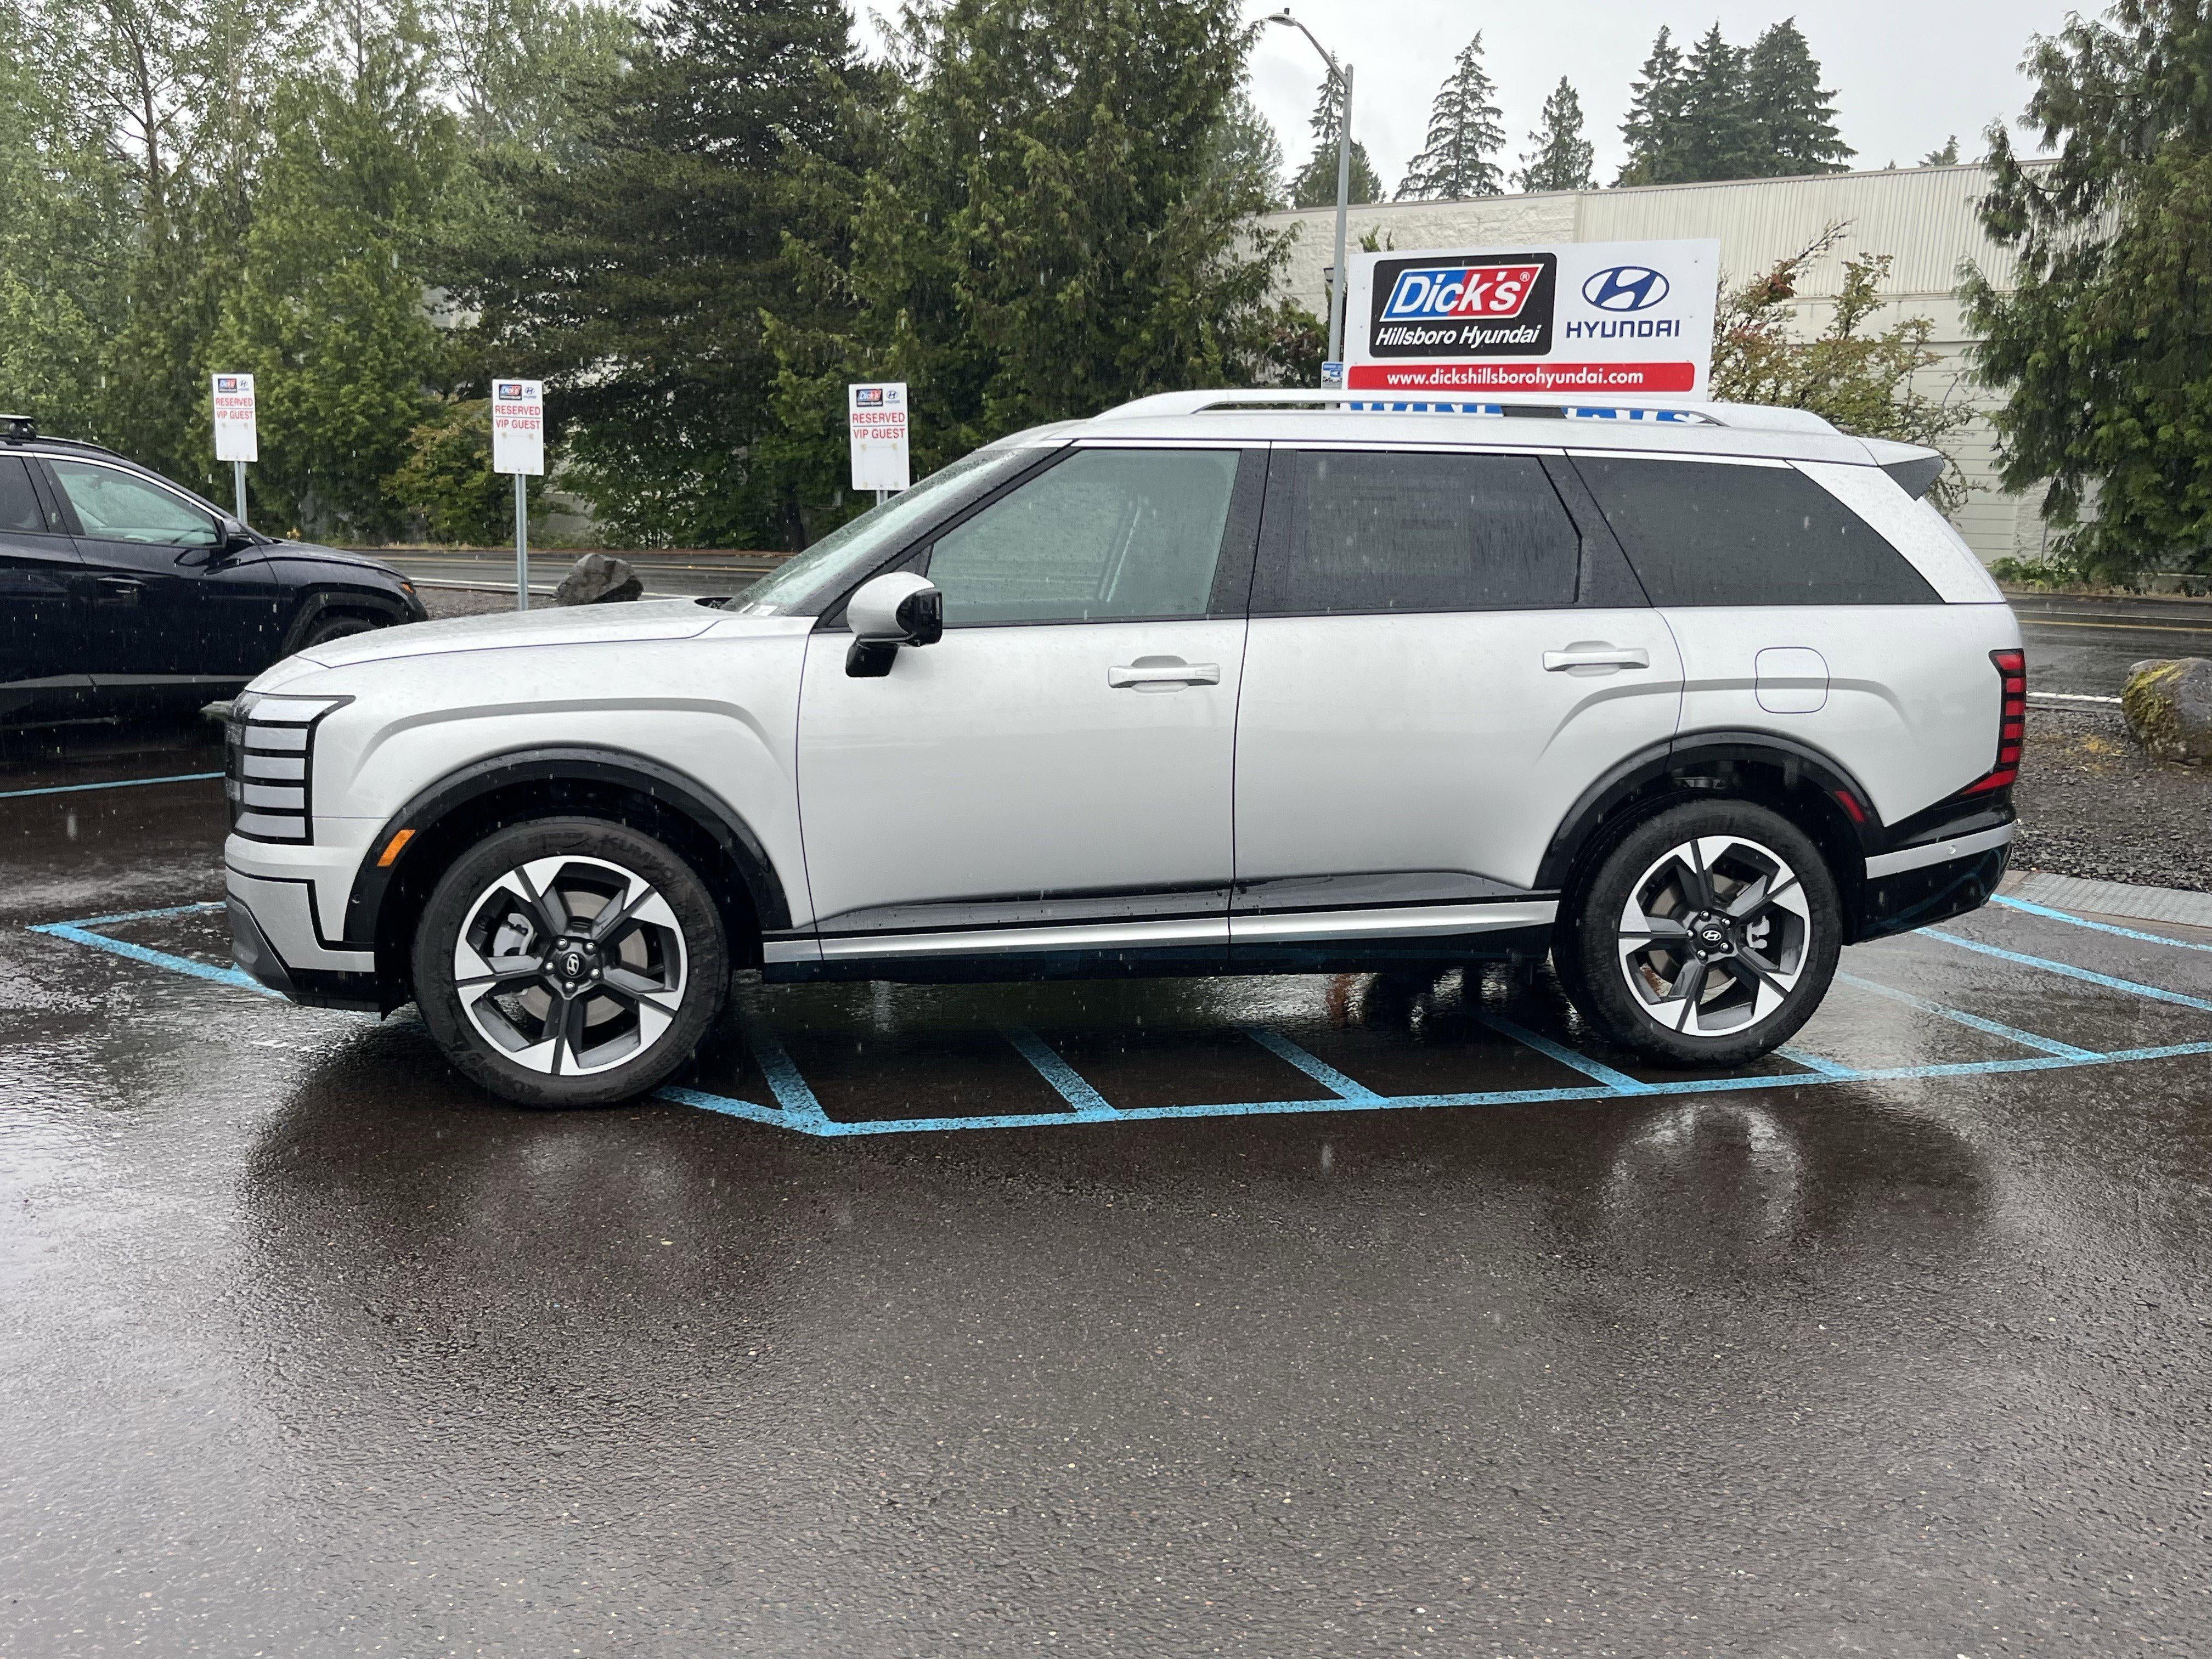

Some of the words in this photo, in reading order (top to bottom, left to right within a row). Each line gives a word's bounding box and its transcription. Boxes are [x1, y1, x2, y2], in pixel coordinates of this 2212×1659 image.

[1392, 272, 1521, 314] Dick's
[1566, 319, 1680, 338] HYUNDAI
[1375, 326, 1457, 346] Hillsboro
[1459, 325, 1542, 349] Hyundai
[1386, 366, 1644, 388] www.dickshillsborohyundai.com
[215, 398, 253, 407] RESERVED
[217, 411, 228, 419] VIP
[229, 410, 253, 420] GUEST
[495, 405, 541, 416] RESERVED
[852, 413, 905, 424] RESERVED
[495, 419, 509, 428] VIP
[512, 419, 541, 430] GUEST
[853, 429, 868, 439] VIP
[871, 428, 905, 439] GUEST
